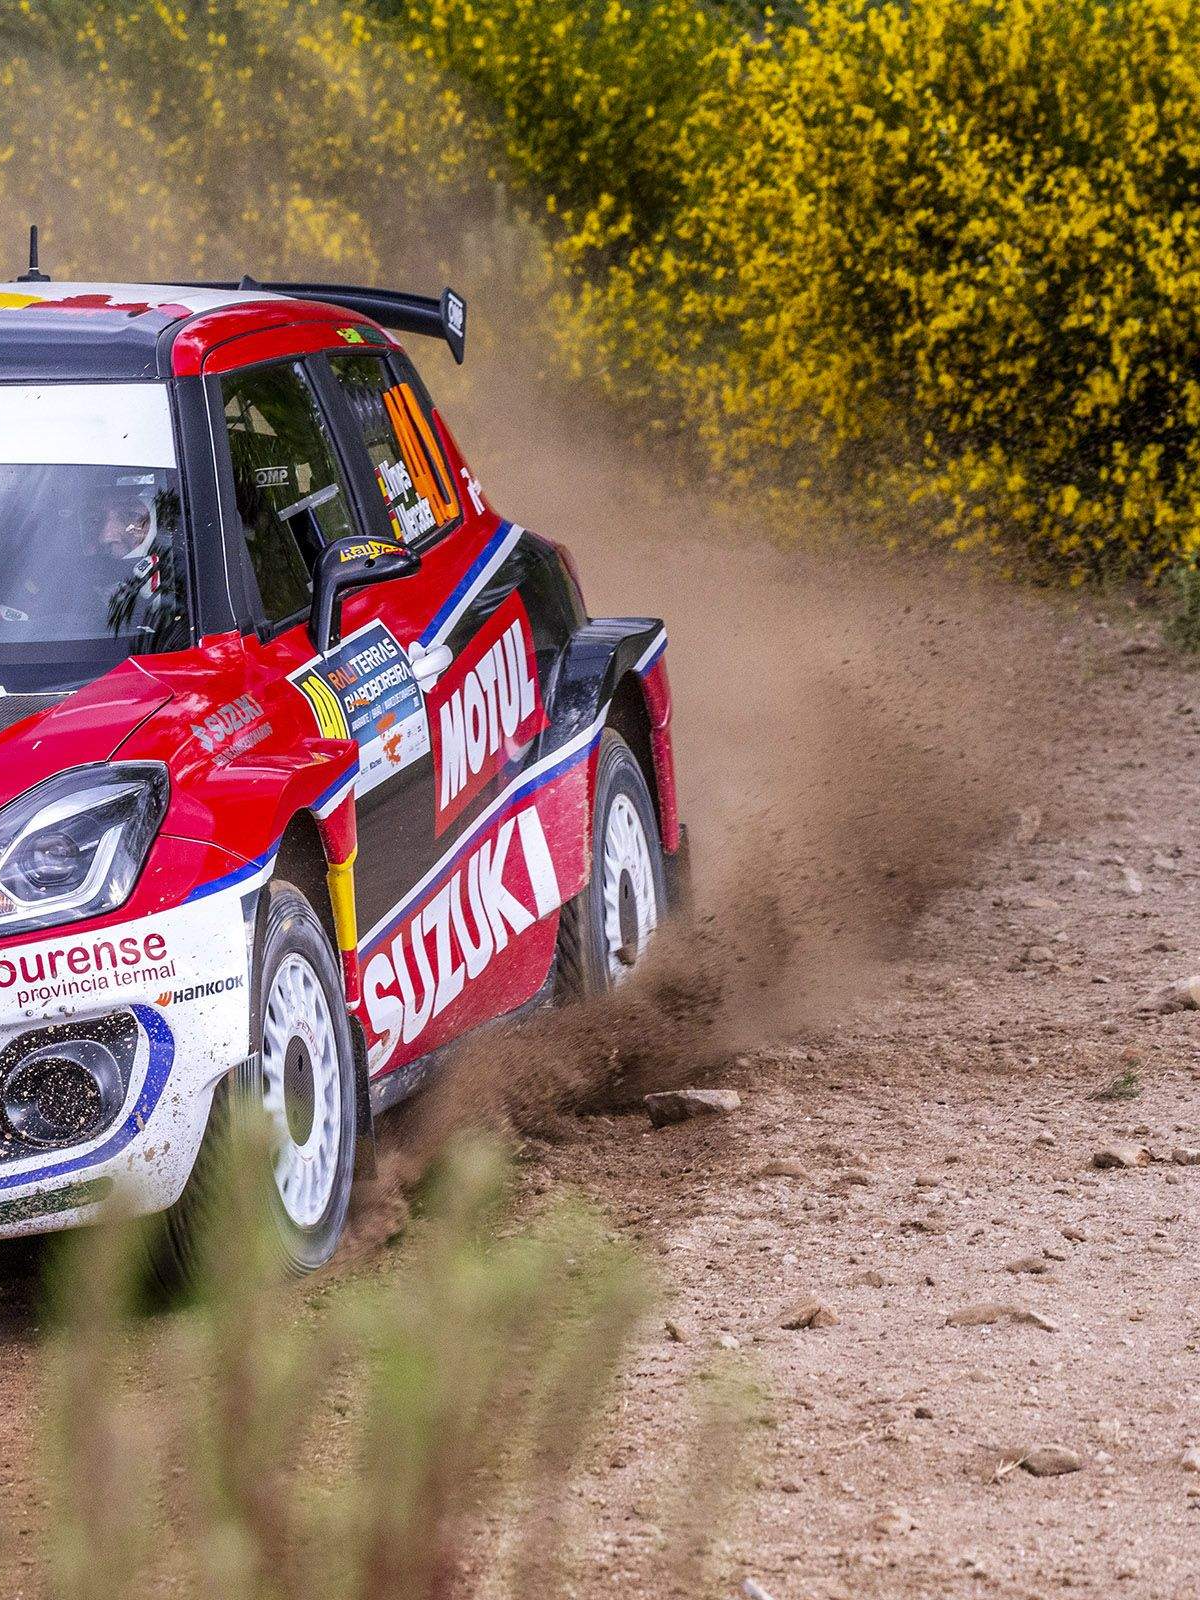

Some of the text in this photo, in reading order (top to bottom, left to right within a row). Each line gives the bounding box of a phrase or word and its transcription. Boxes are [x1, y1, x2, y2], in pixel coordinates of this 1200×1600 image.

[256, 470, 289, 484] OMP
[383, 383, 459, 527] 40
[327, 637, 398, 692] RALI TERRAS
[204, 693, 264, 741] SUZUKI
[439, 618, 537, 811] MOTUL
[363, 805, 562, 1078] SUZUKI
[17, 960, 176, 1008] provincia termal
